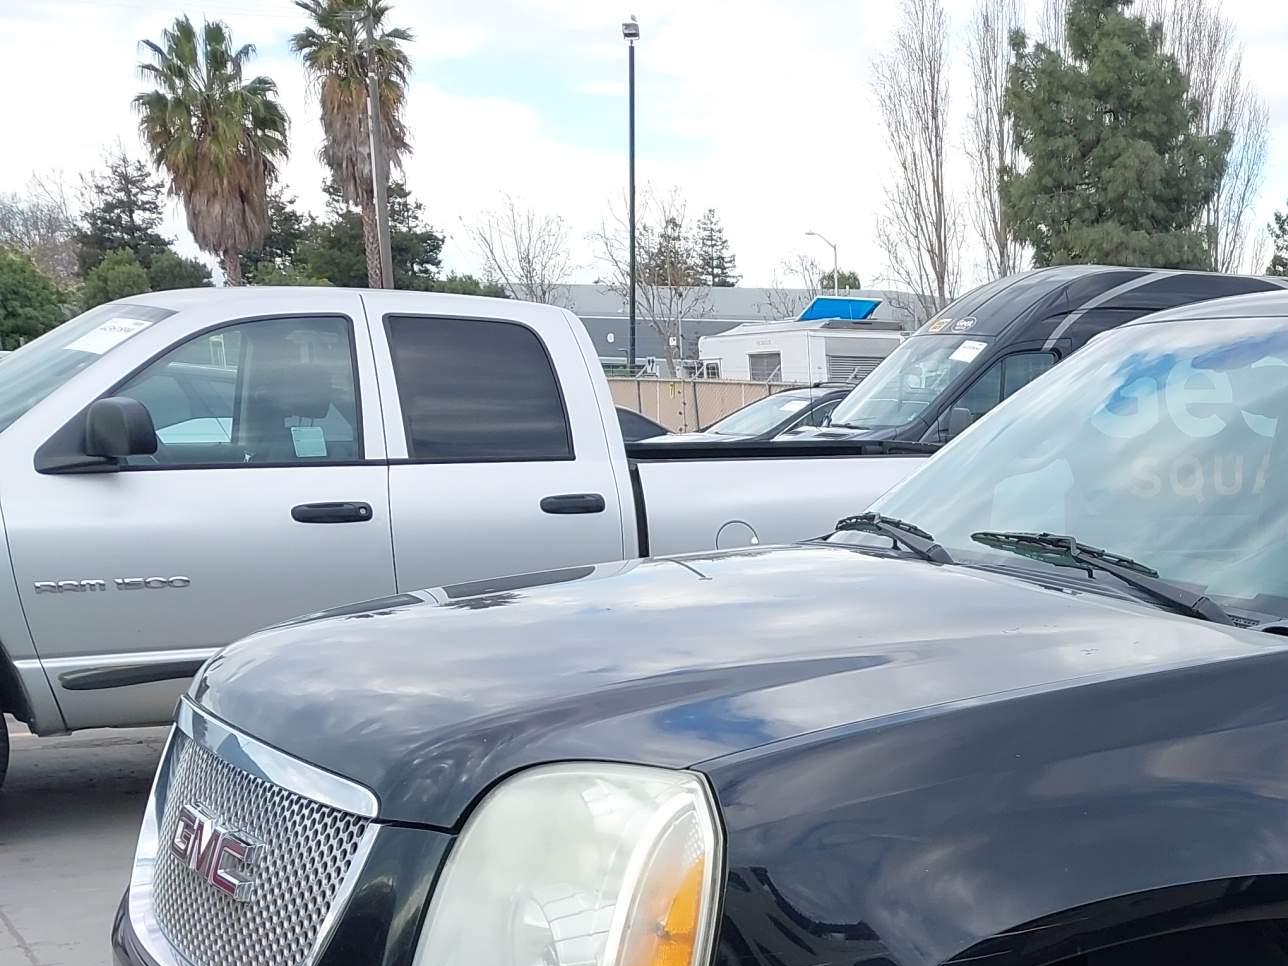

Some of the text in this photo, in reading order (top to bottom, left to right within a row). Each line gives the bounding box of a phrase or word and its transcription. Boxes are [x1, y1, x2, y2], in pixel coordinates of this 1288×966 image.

[34, 575, 190, 594] RAM 1500
[172, 801, 266, 902] GMC
